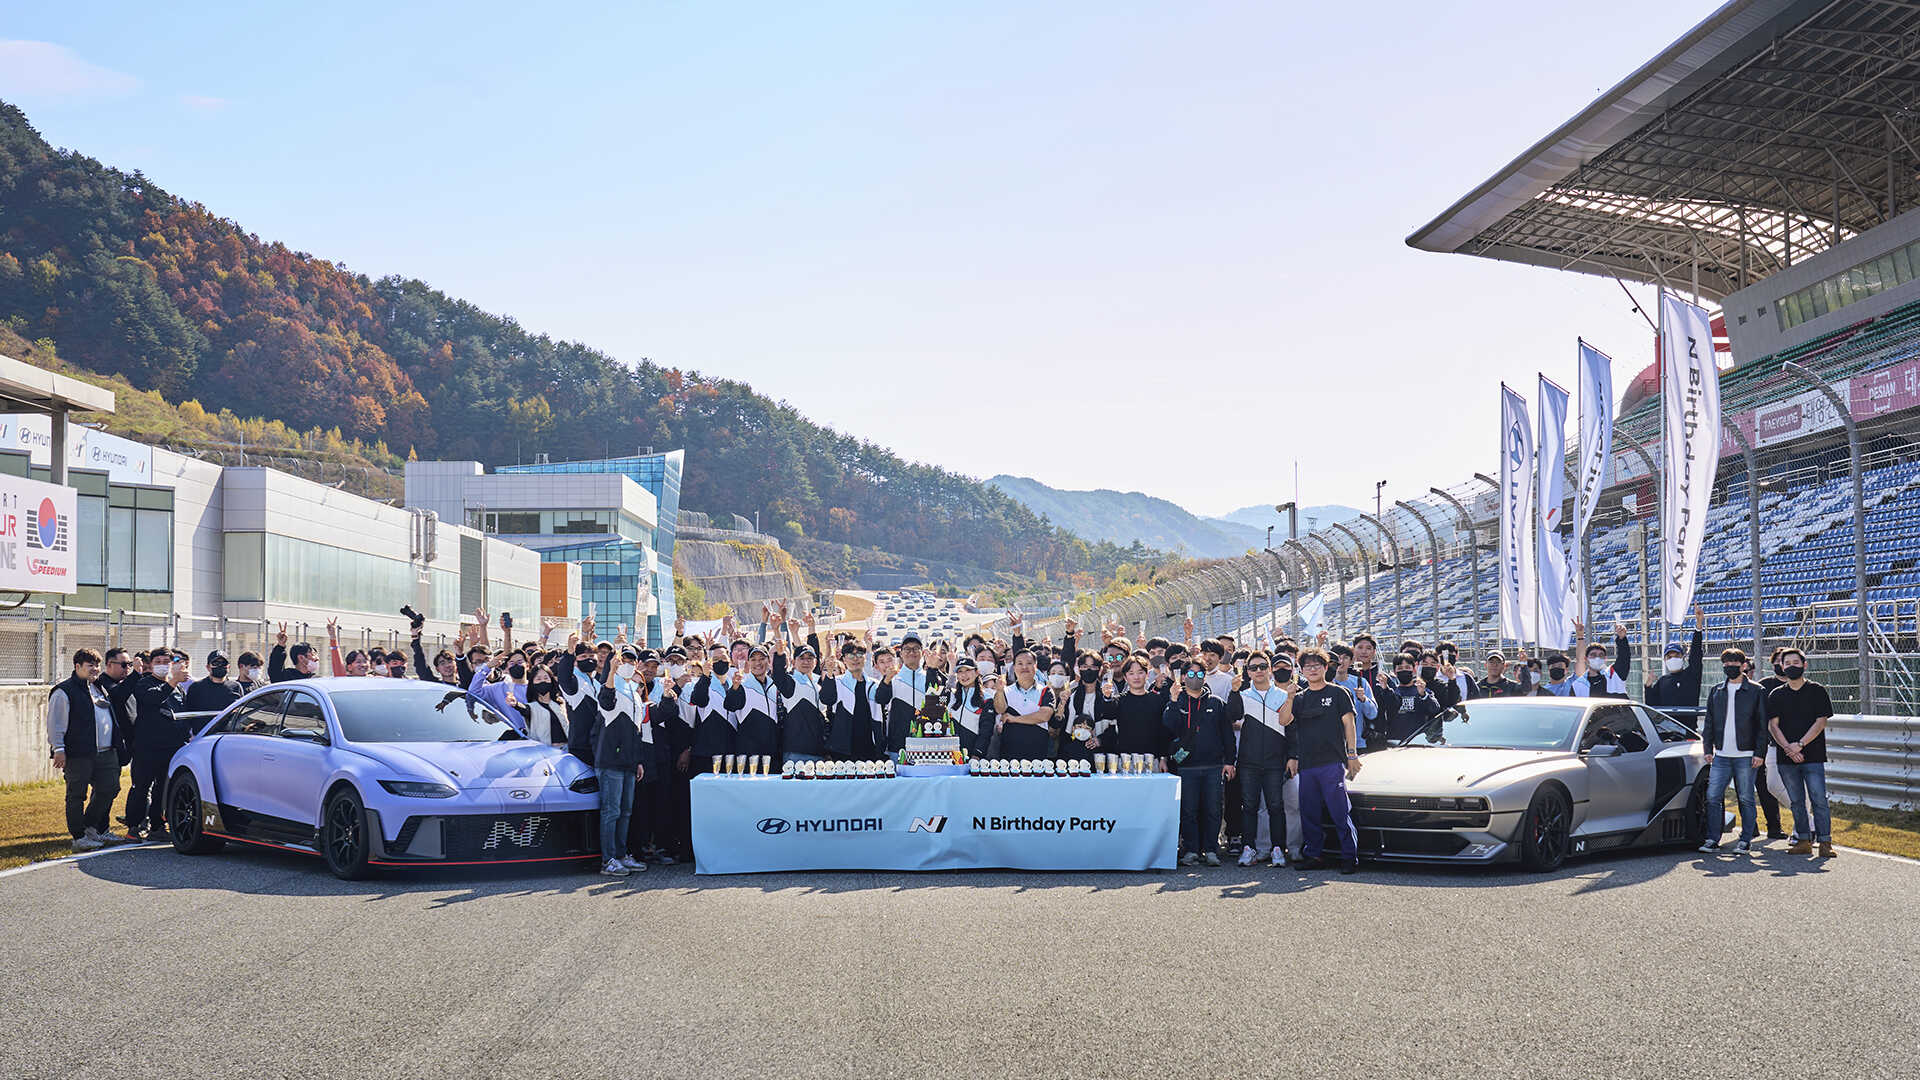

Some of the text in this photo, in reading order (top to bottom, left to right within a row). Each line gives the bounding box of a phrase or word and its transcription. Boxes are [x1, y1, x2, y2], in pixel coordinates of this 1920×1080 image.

[1904, 366, 1920, 397] 데
[1672, 336, 1702, 590] N Birthday Party
[205, 815, 215, 826] N
[796, 818, 883, 833] HYUNDAI
[972, 816, 1116, 834] N Birthday Party
[1576, 841, 1585, 852] N
